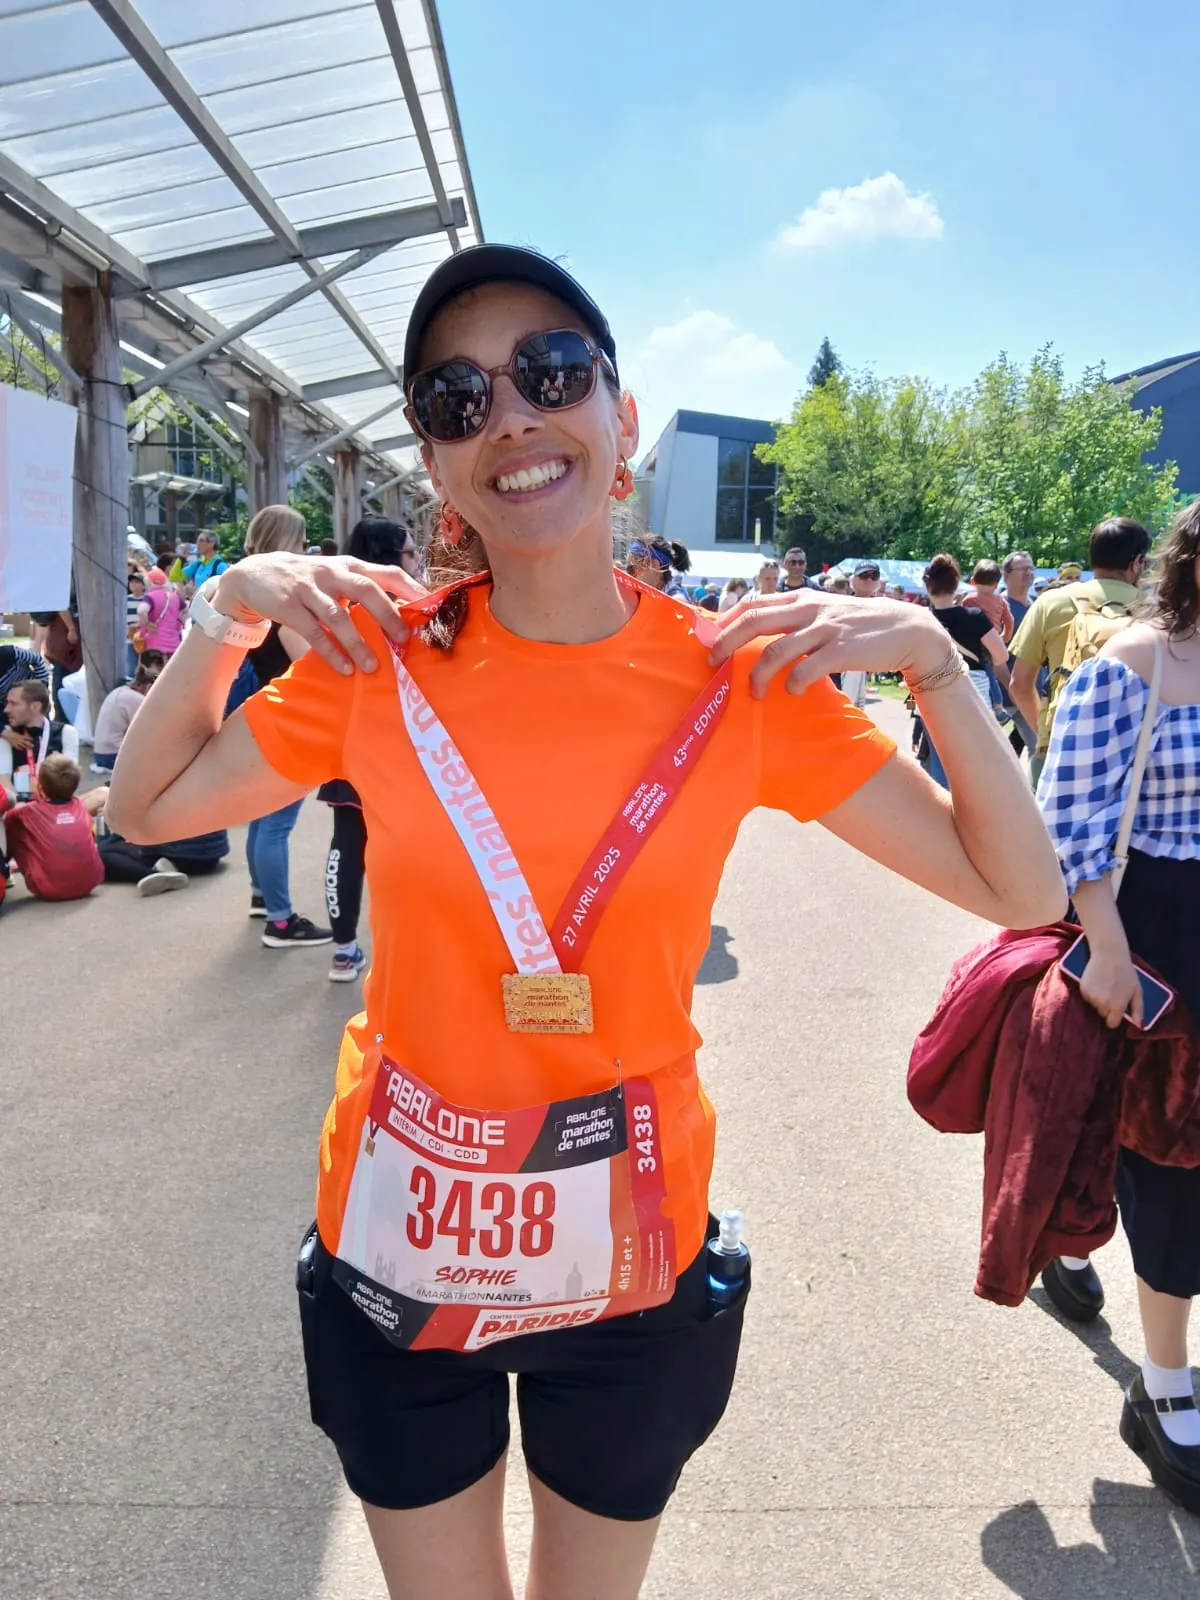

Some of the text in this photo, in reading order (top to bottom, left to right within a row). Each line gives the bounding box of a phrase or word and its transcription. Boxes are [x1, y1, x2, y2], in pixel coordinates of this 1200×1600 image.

[693, 680, 730, 737] ÉDITION
[635, 819, 647, 835] de
[325, 848, 341, 919] adidas
[562, 847, 621, 948] 27 AVRIL 2025
[386, 1071, 506, 1145] ABALONE
[566, 1106, 607, 1125] ABALONE
[428, 1138, 444, 1153] CDI
[454, 1148, 480, 1160] CDD
[558, 1140, 573, 1152] de
[633, 1105, 656, 1173] 3438
[405, 1164, 557, 1260] 3438
[623, 1247, 633, 1260] et
[434, 1265, 518, 1287] SOPHIE
[618, 1264, 632, 1291] 4h15
[356, 1281, 393, 1307] ABALONE
[416, 1287, 533, 1304] #MARATHONNANTES
[478, 1307, 597, 1338] PARIDIS
